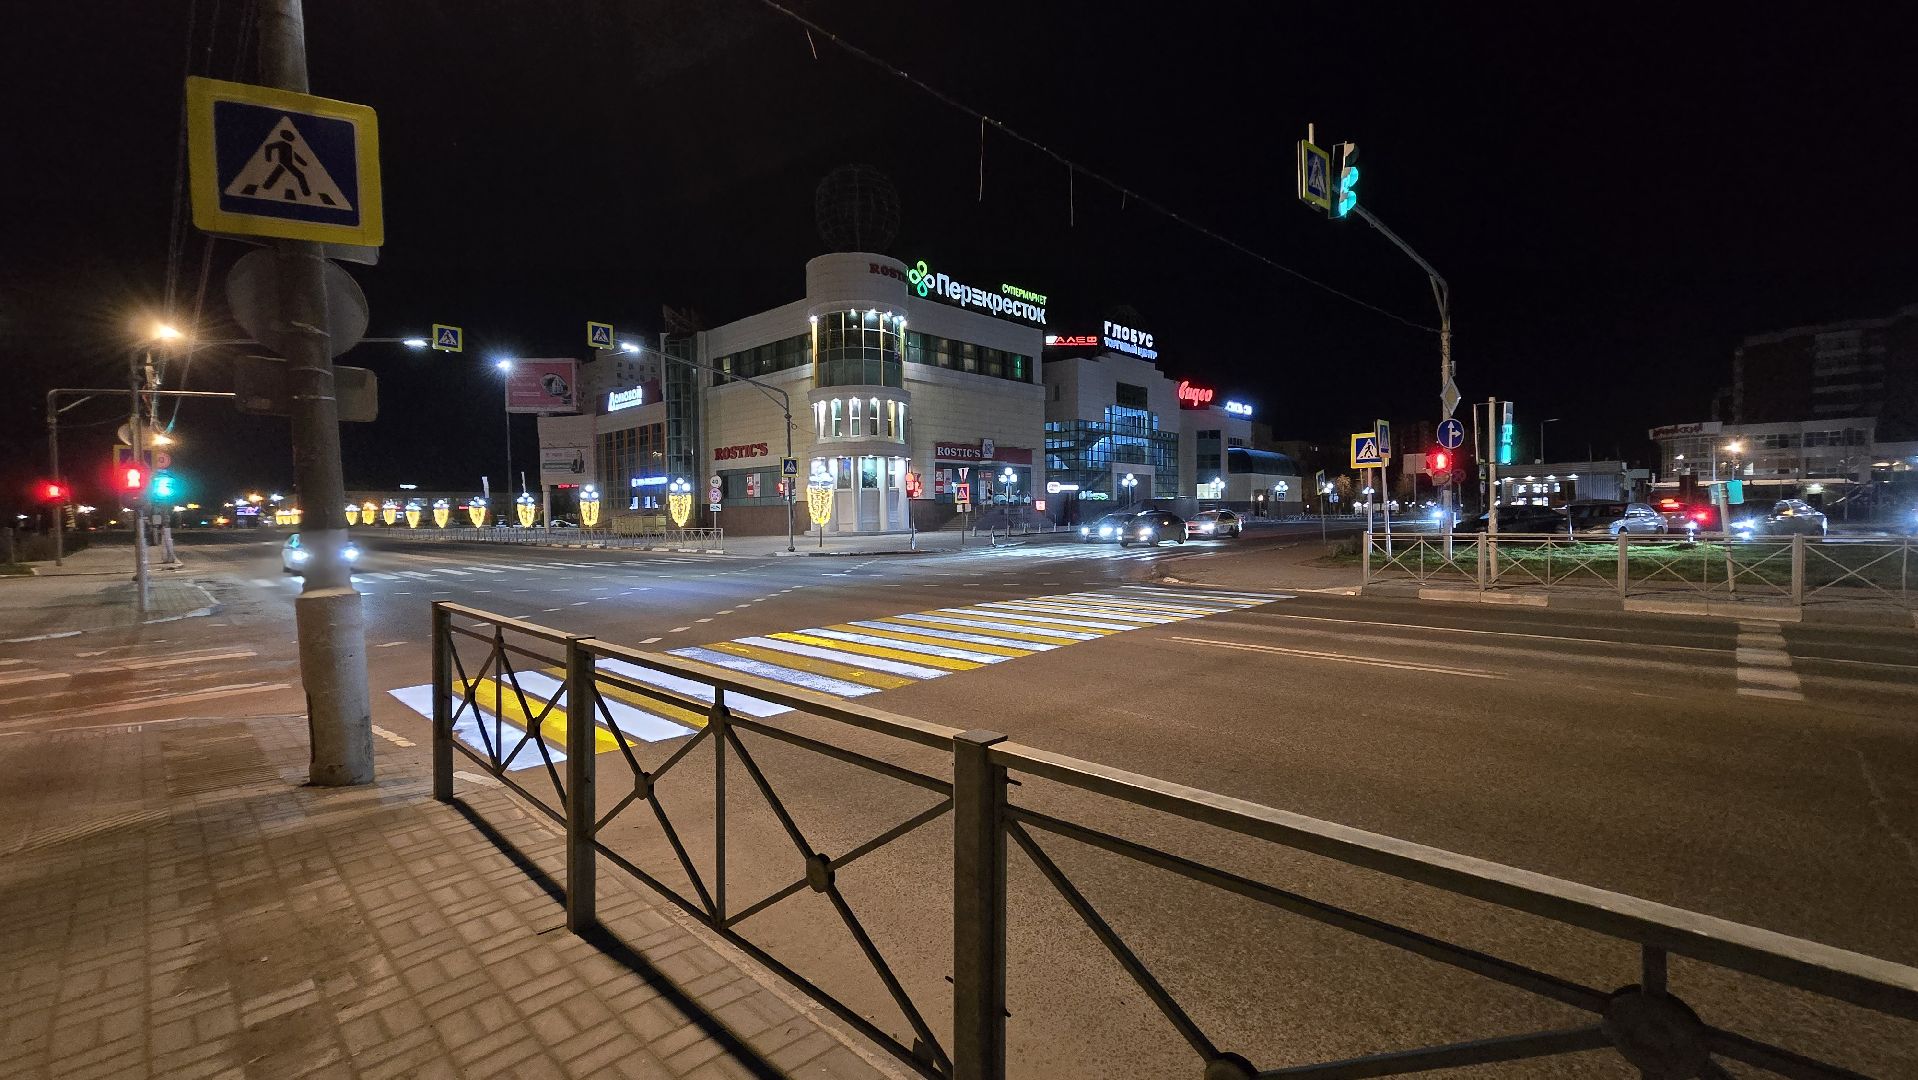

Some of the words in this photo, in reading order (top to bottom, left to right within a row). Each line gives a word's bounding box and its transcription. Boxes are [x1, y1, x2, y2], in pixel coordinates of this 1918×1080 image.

[936, 272, 1047, 325] Перекресток
[1001, 283, 1048, 306] СУПЕРМАРКЕТ
[1104, 320, 1154, 348] ГЛОБУС
[714, 442, 769, 461] ROSTIC'S
[937, 446, 981, 458] ROSTIC'S
